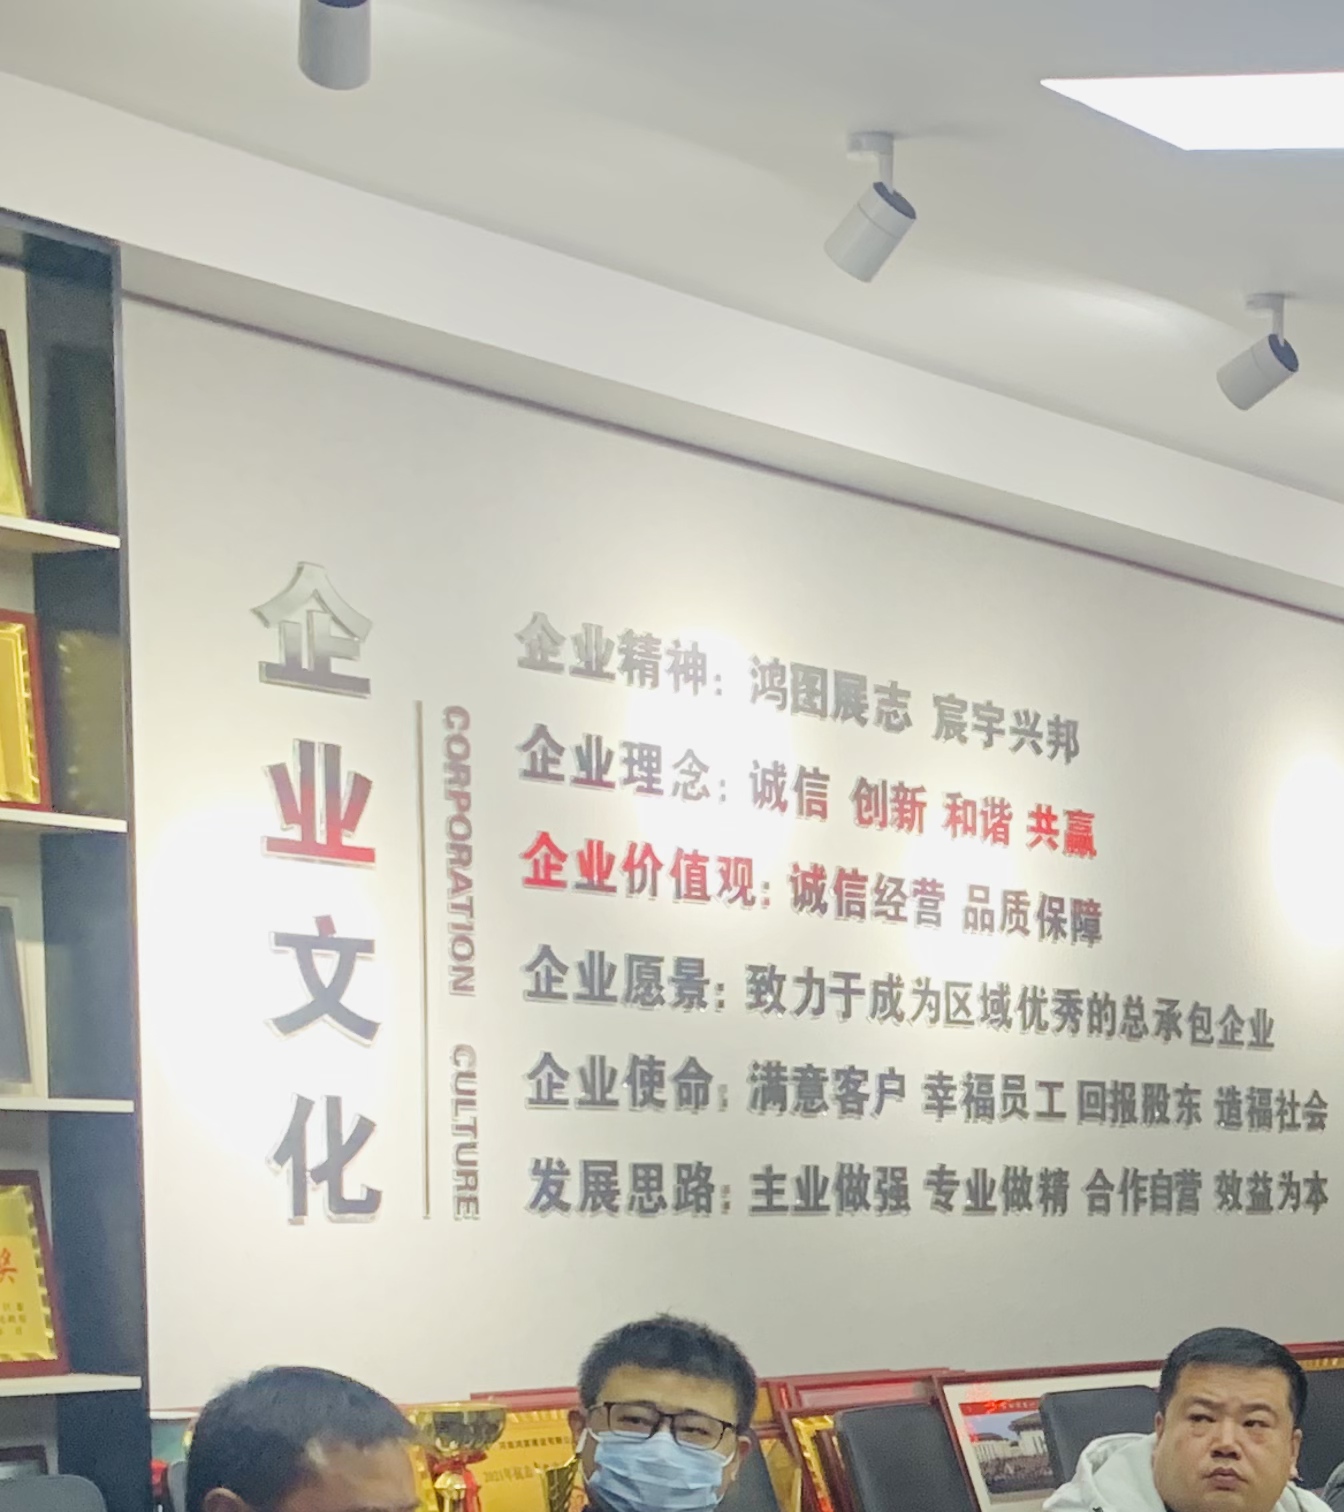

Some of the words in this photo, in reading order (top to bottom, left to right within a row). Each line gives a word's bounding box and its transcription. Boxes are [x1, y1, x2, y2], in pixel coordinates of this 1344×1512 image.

[931, 692, 1080, 765] 宸宇兴邦
[443, 705, 476, 997] CORPORATION
[849, 776, 927, 836] 创新
[942, 791, 1013, 848] 和谐
[1025, 803, 1098, 860] 共赢
[250, 561, 382, 1225] 企业文化
[962, 883, 1103, 948] 品质保障
[449, 1043, 481, 1221] CULTURE
[921, 1069, 1067, 1125] 幸福员工
[1077, 1079, 1202, 1129] 回报股东
[1214, 1085, 1328, 1134] 造福社会
[923, 1163, 1070, 1217] 专业做精
[1081, 1166, 1202, 1216] 合作自营
[1214, 1168, 1329, 1216] 效益为本
